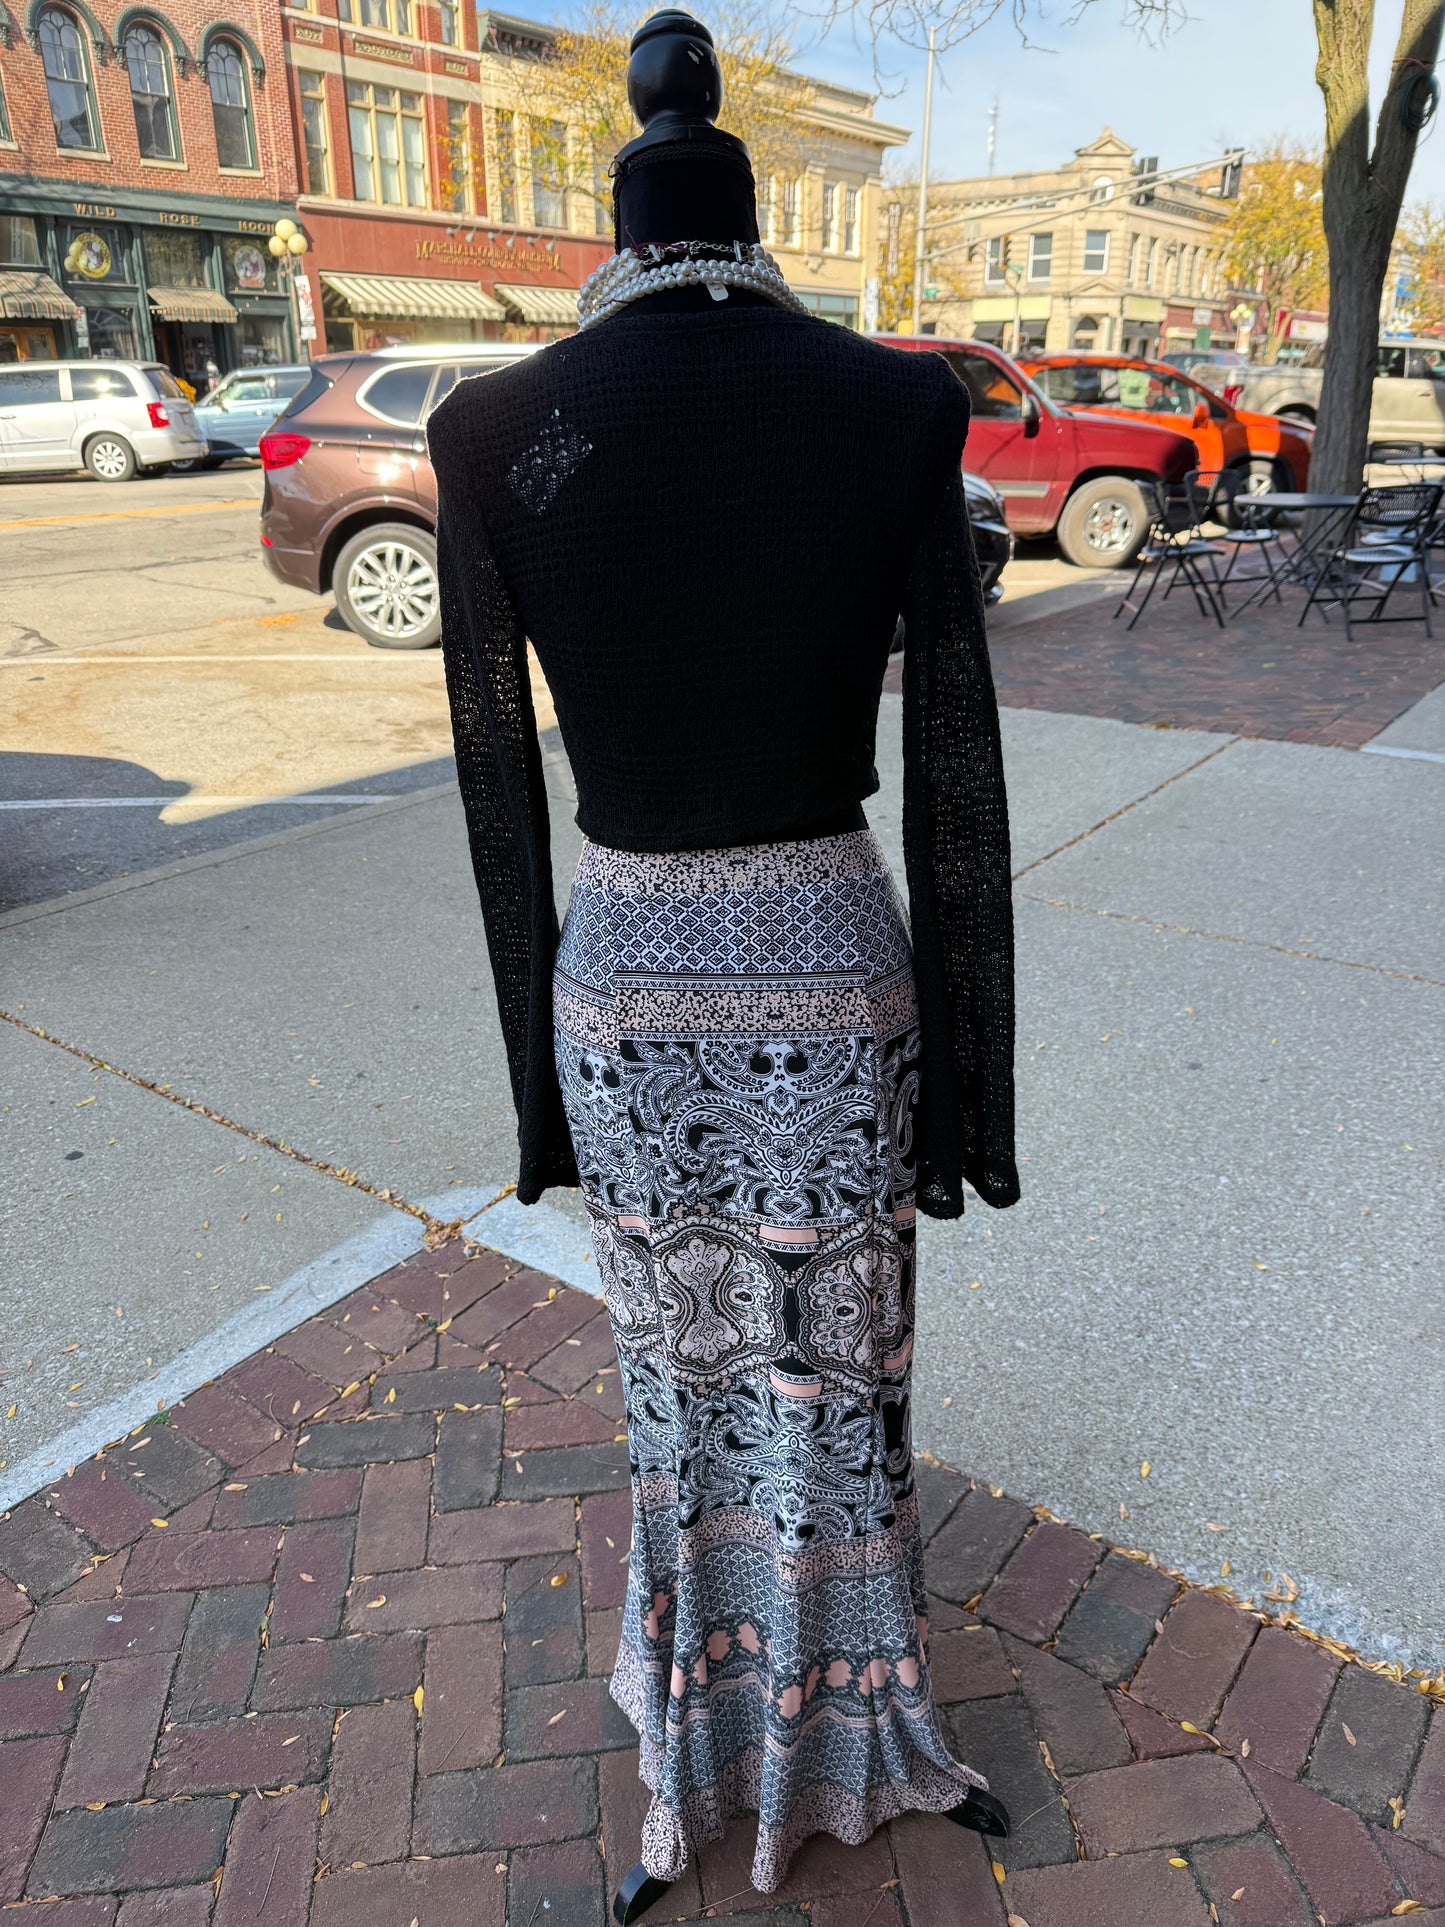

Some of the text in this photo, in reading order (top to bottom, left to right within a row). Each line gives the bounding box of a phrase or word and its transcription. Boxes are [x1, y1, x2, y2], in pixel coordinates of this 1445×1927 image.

[73, 203, 276, 234] WILD ROSE MOON
